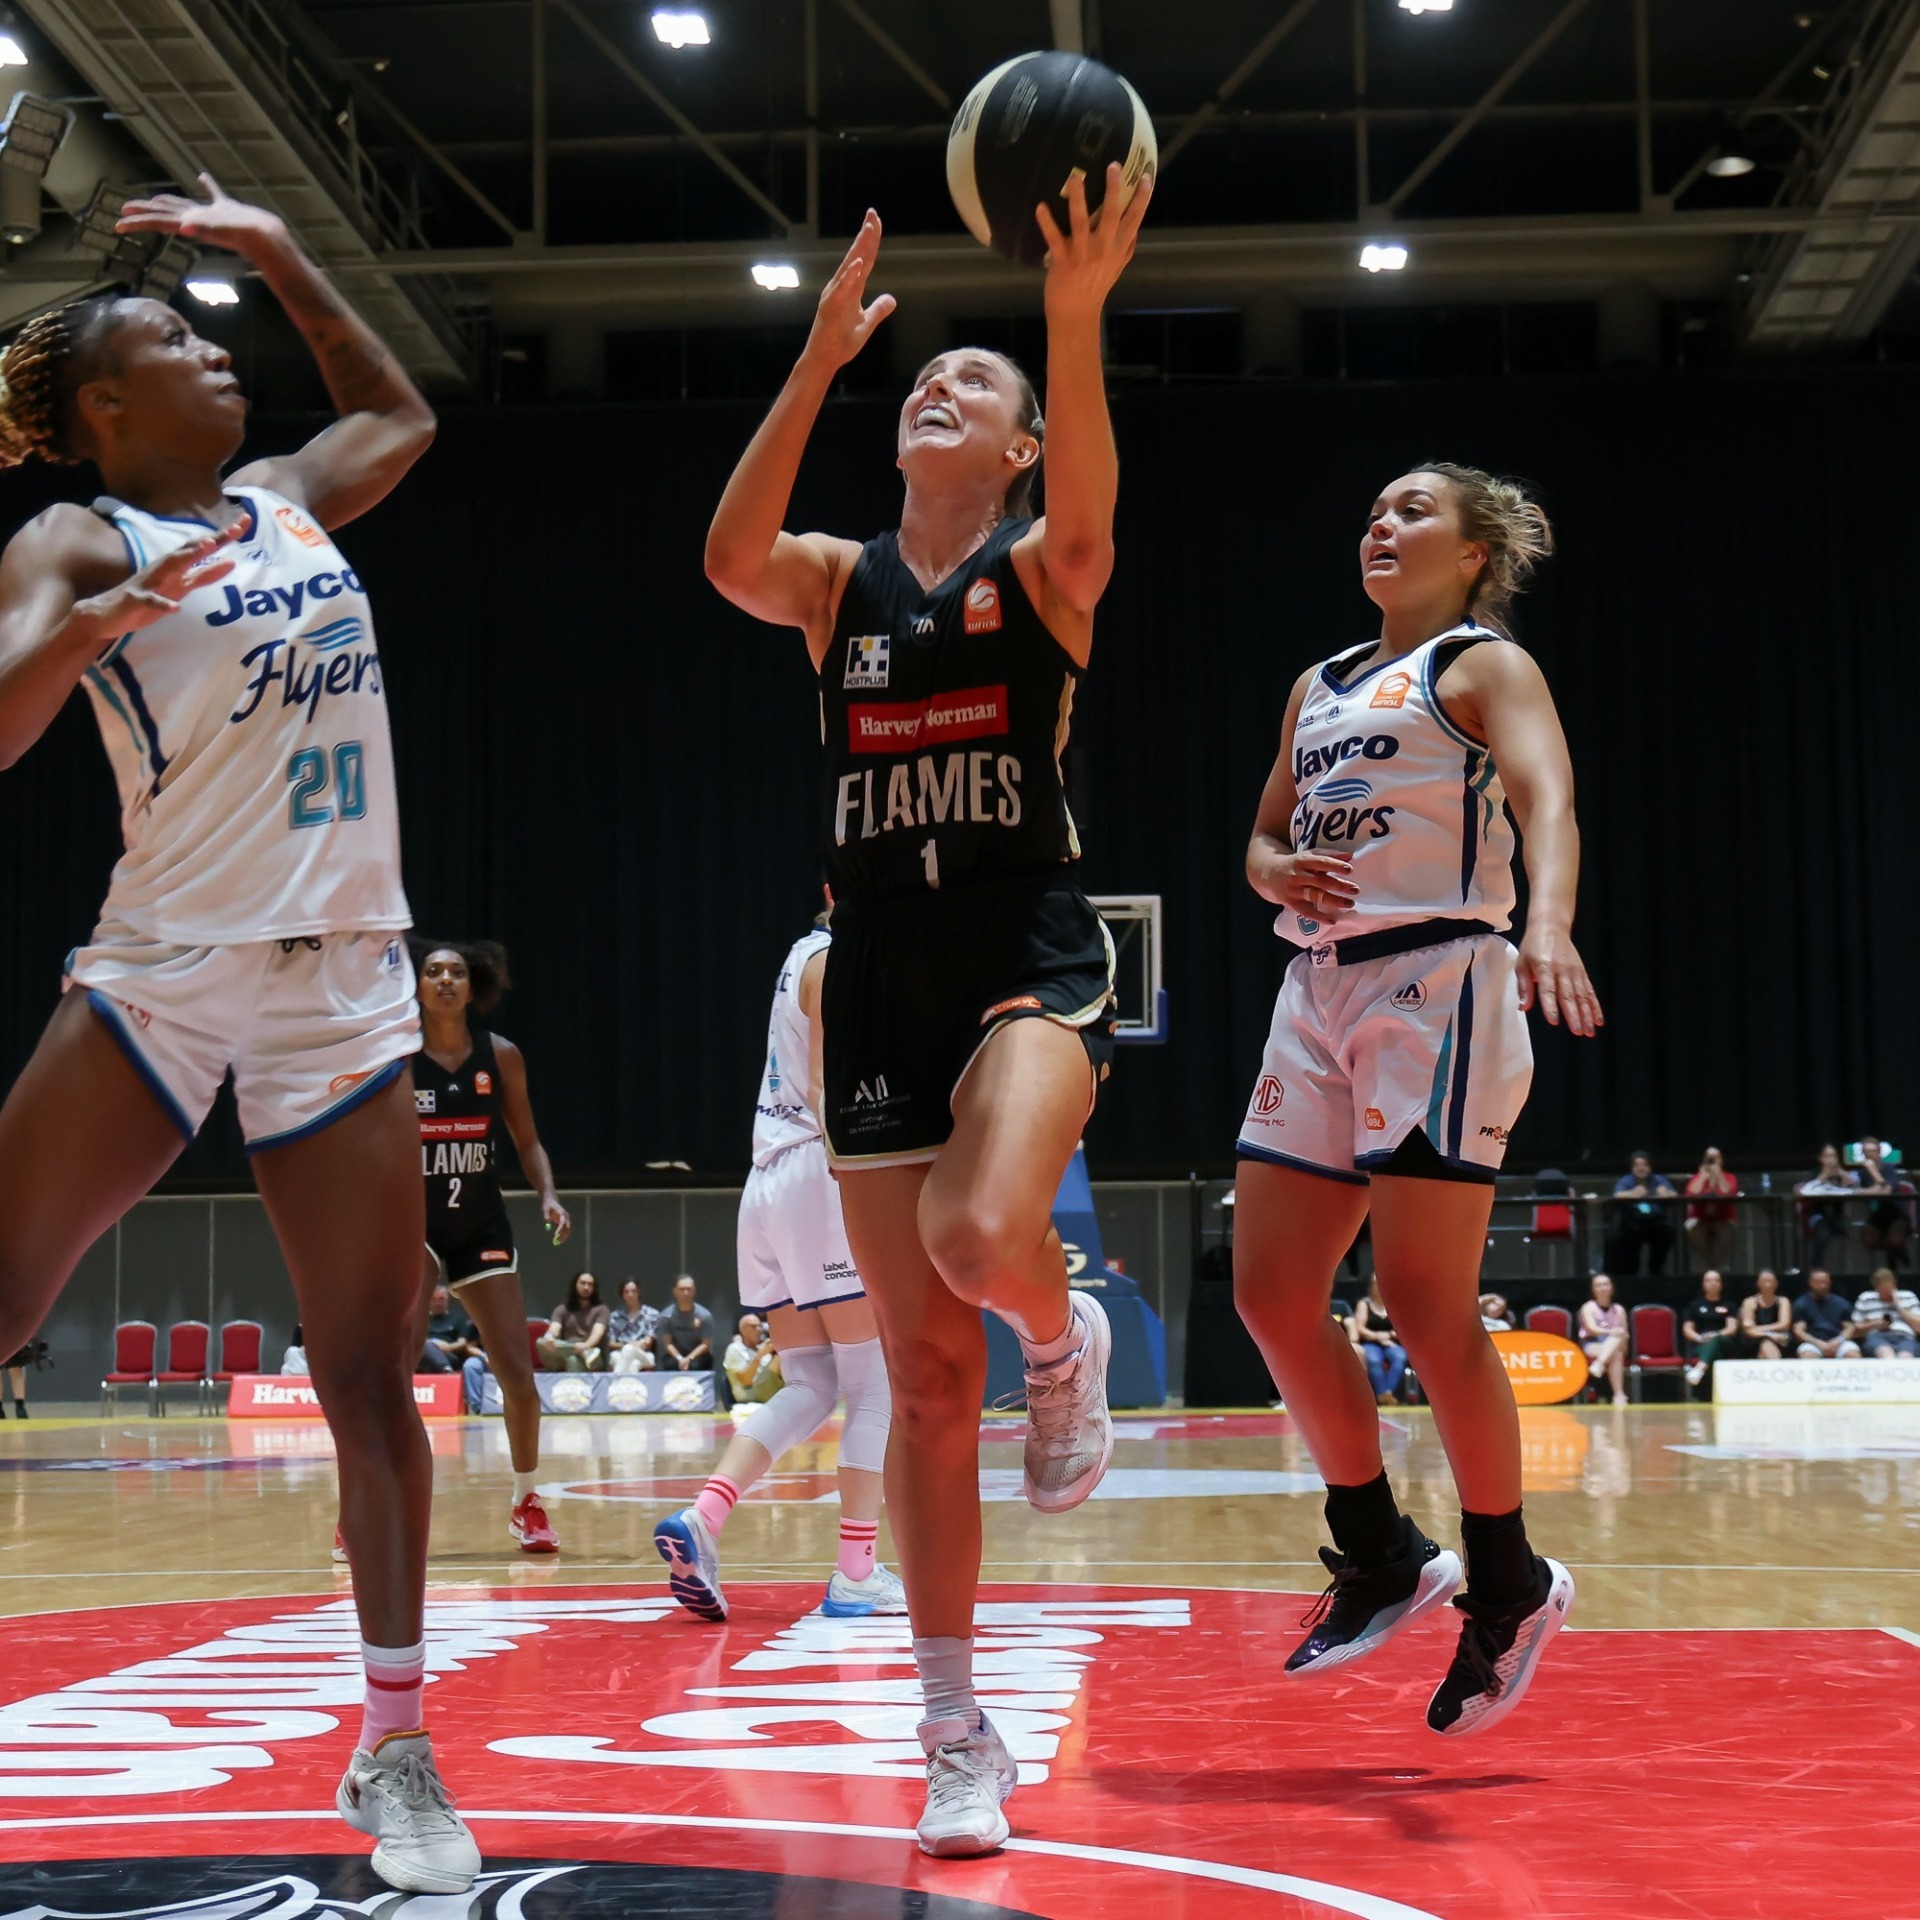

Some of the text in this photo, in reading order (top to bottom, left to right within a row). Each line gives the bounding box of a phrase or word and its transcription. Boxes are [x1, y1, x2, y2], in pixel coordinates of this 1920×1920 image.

[205, 566, 367, 628] Jayco
[845, 676, 887, 687] HOSTPLUS
[859, 716, 921, 738] Harvey
[1293, 734, 1400, 787] Jayco
[287, 740, 367, 831] 20
[834, 750, 1022, 847] FLAMES
[920, 837, 940, 890] 1
[1255, 1078, 1281, 1112] MG
[1271, 1118, 1286, 1127] MG
[447, 1177, 462, 1209] 2
[822, 1260, 849, 1272] label
[1731, 1367, 1805, 1384] SALON
